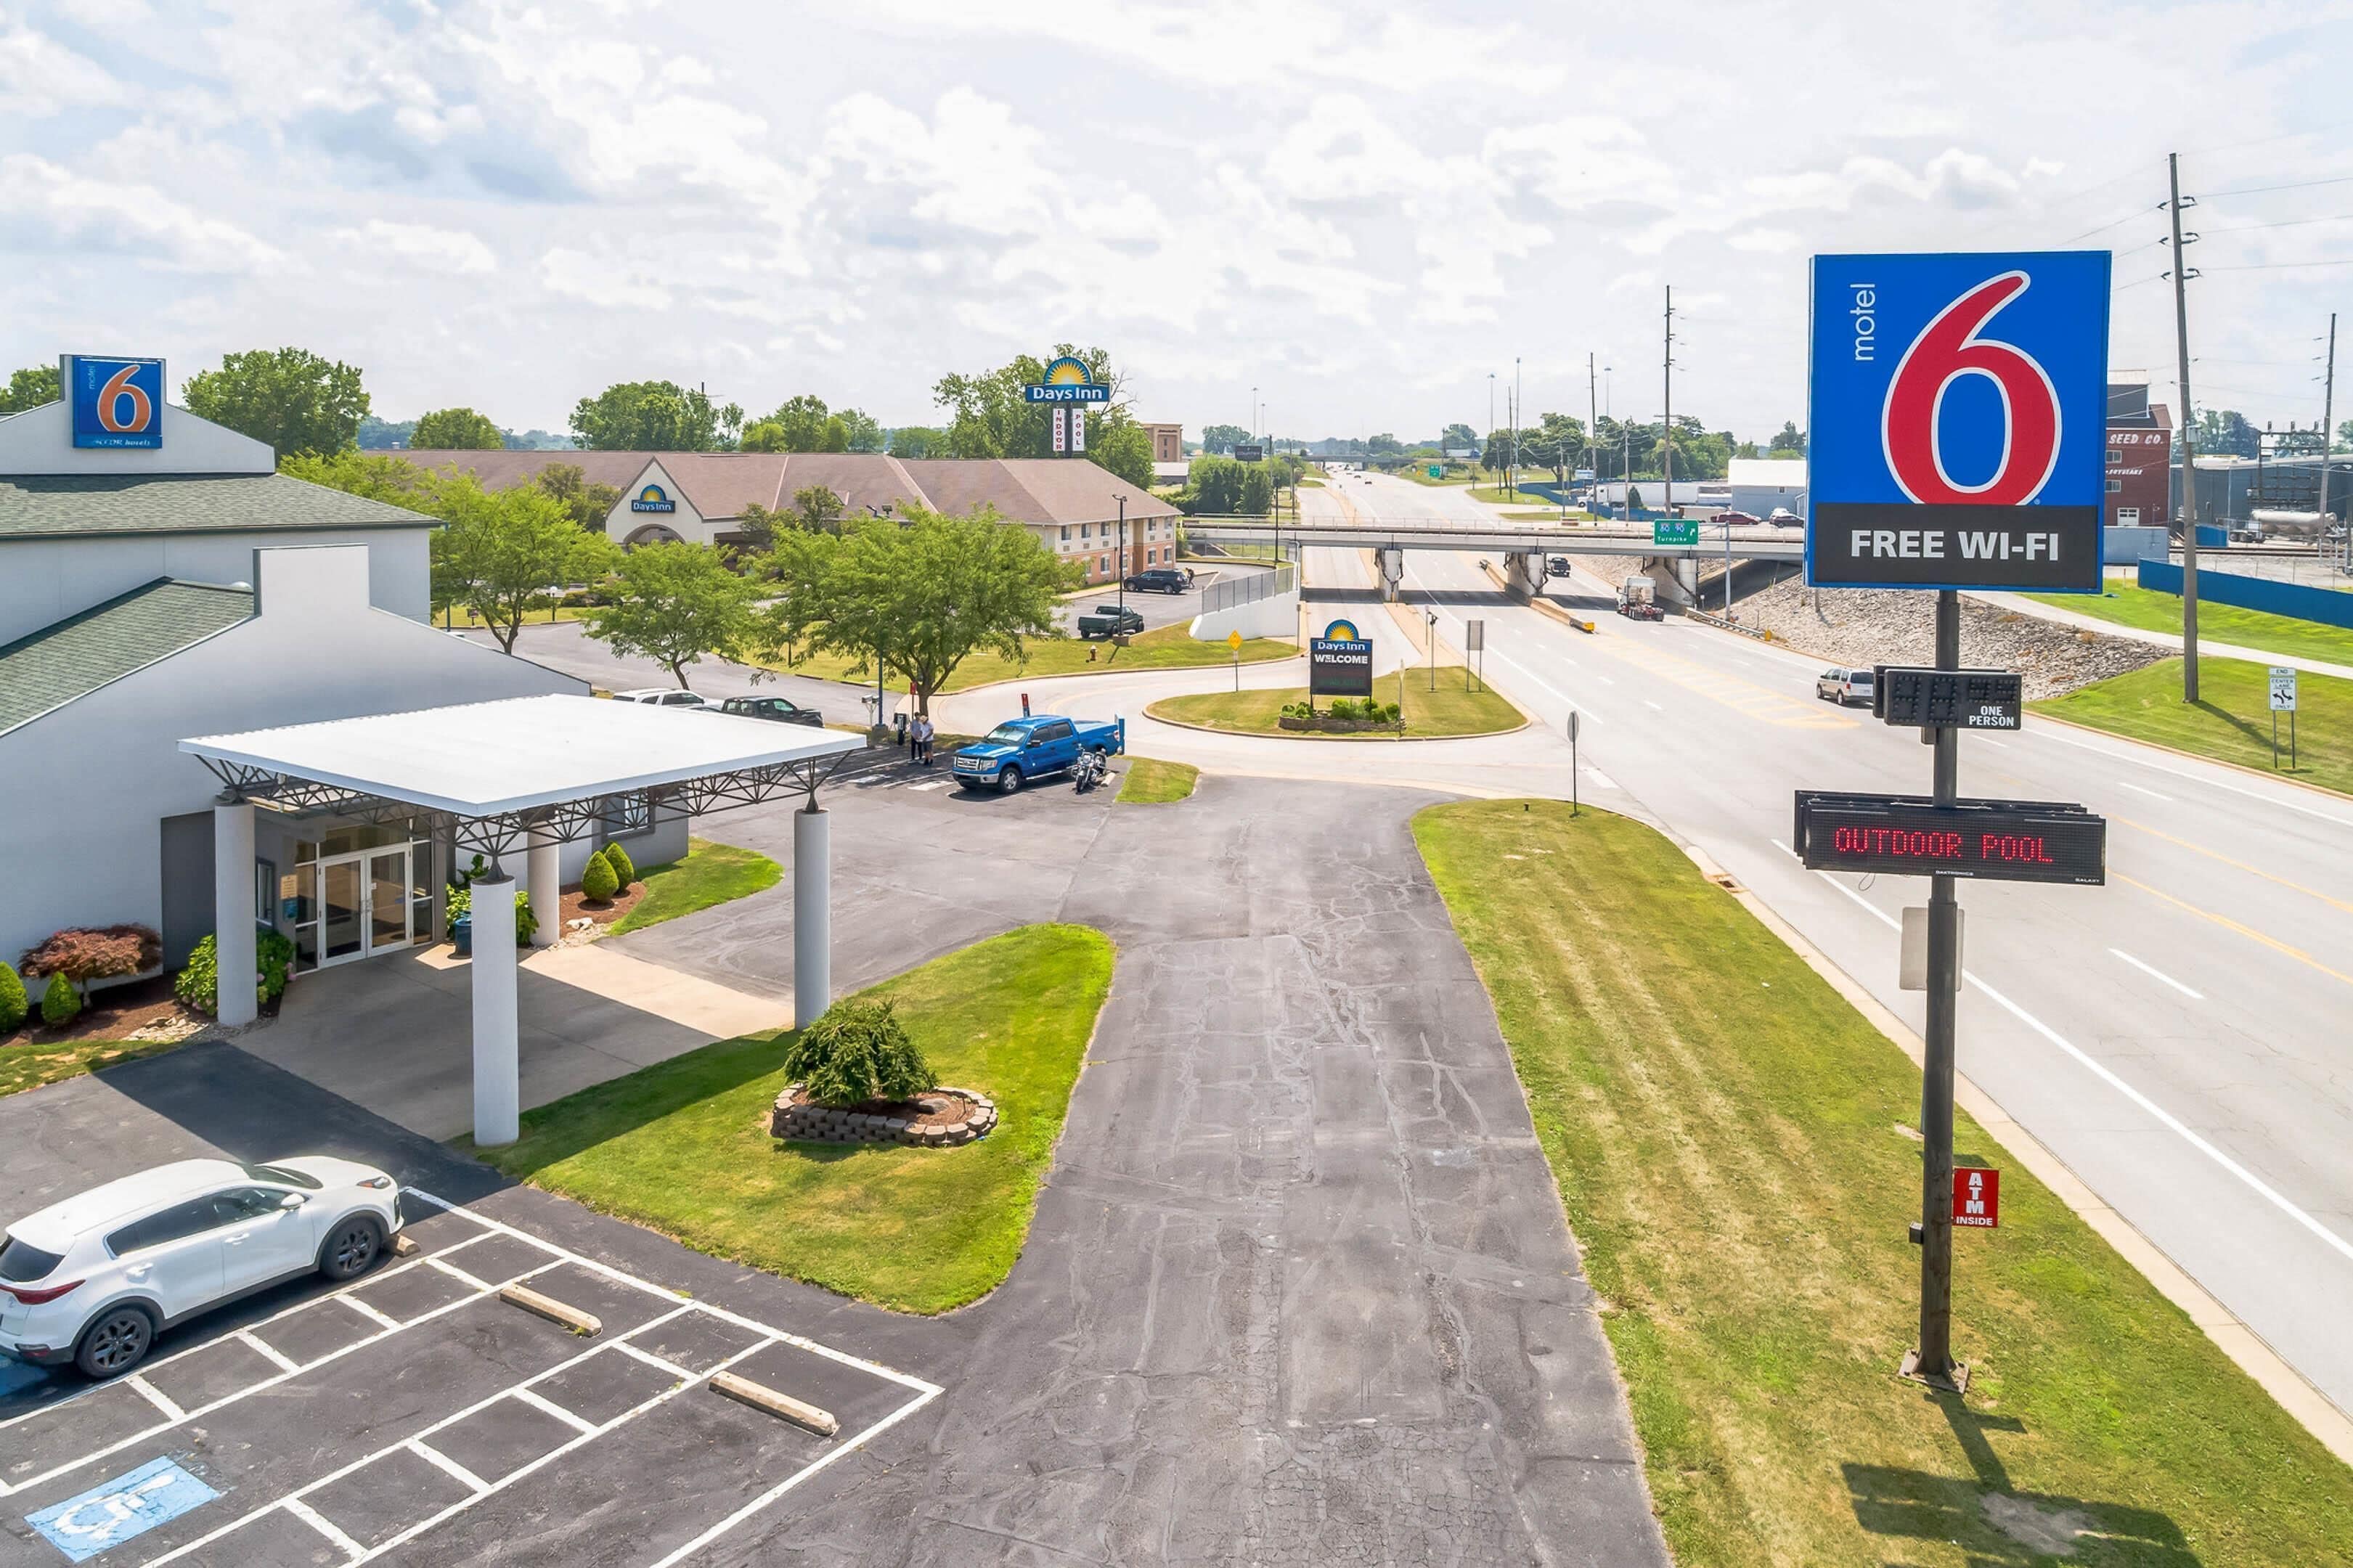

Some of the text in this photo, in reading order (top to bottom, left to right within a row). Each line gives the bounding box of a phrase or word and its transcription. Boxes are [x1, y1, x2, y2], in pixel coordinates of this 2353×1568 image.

[1850, 269, 2063, 505] motel 6
[97, 364, 152, 433] 6
[1033, 387, 1103, 401] Days Inn
[2108, 433, 2164, 444] SEED CO.
[633, 502, 655, 512] Days
[1851, 529, 2059, 561] FREE WI-FI
[1318, 642, 1366, 651] Days Inn
[1314, 654, 1369, 664] WELCOME
[1981, 706, 2003, 716] ONE
[1968, 715, 2015, 727] PERSON
[1834, 828, 2053, 863] OUTDOOR POOL
[1965, 1172, 1984, 1214] ATM
[1956, 1216, 1993, 1226] INSIDE
